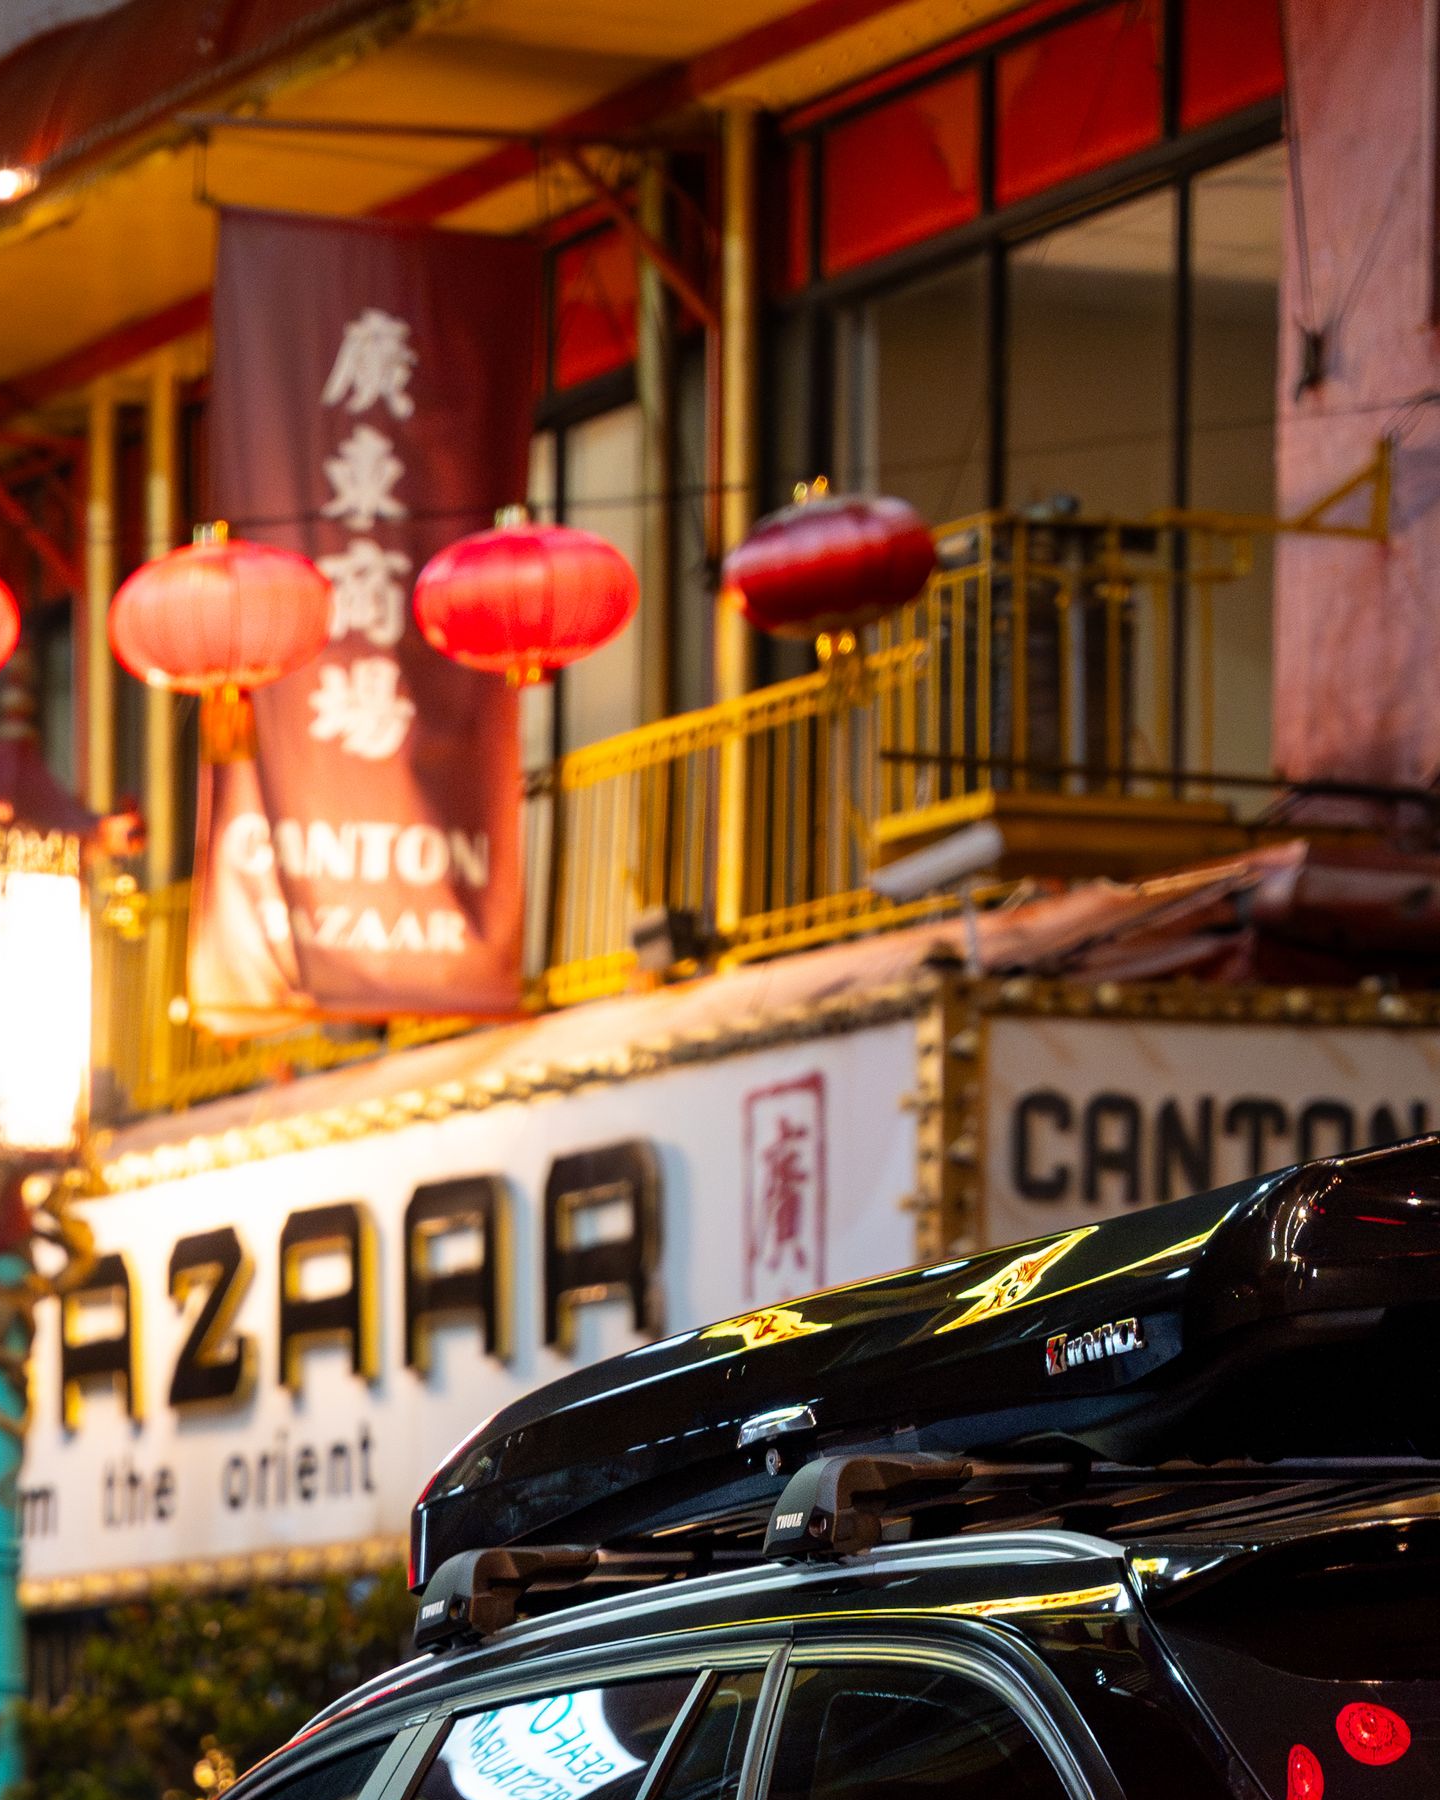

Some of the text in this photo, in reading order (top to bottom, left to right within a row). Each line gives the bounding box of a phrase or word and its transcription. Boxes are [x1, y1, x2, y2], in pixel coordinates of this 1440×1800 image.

[220, 811, 491, 889] CANTON
[763, 1114, 810, 1298] 廣
[102, 1451, 177, 1528] the
[222, 1421, 375, 1512] orient
[776, 1512, 804, 1530] THULE
